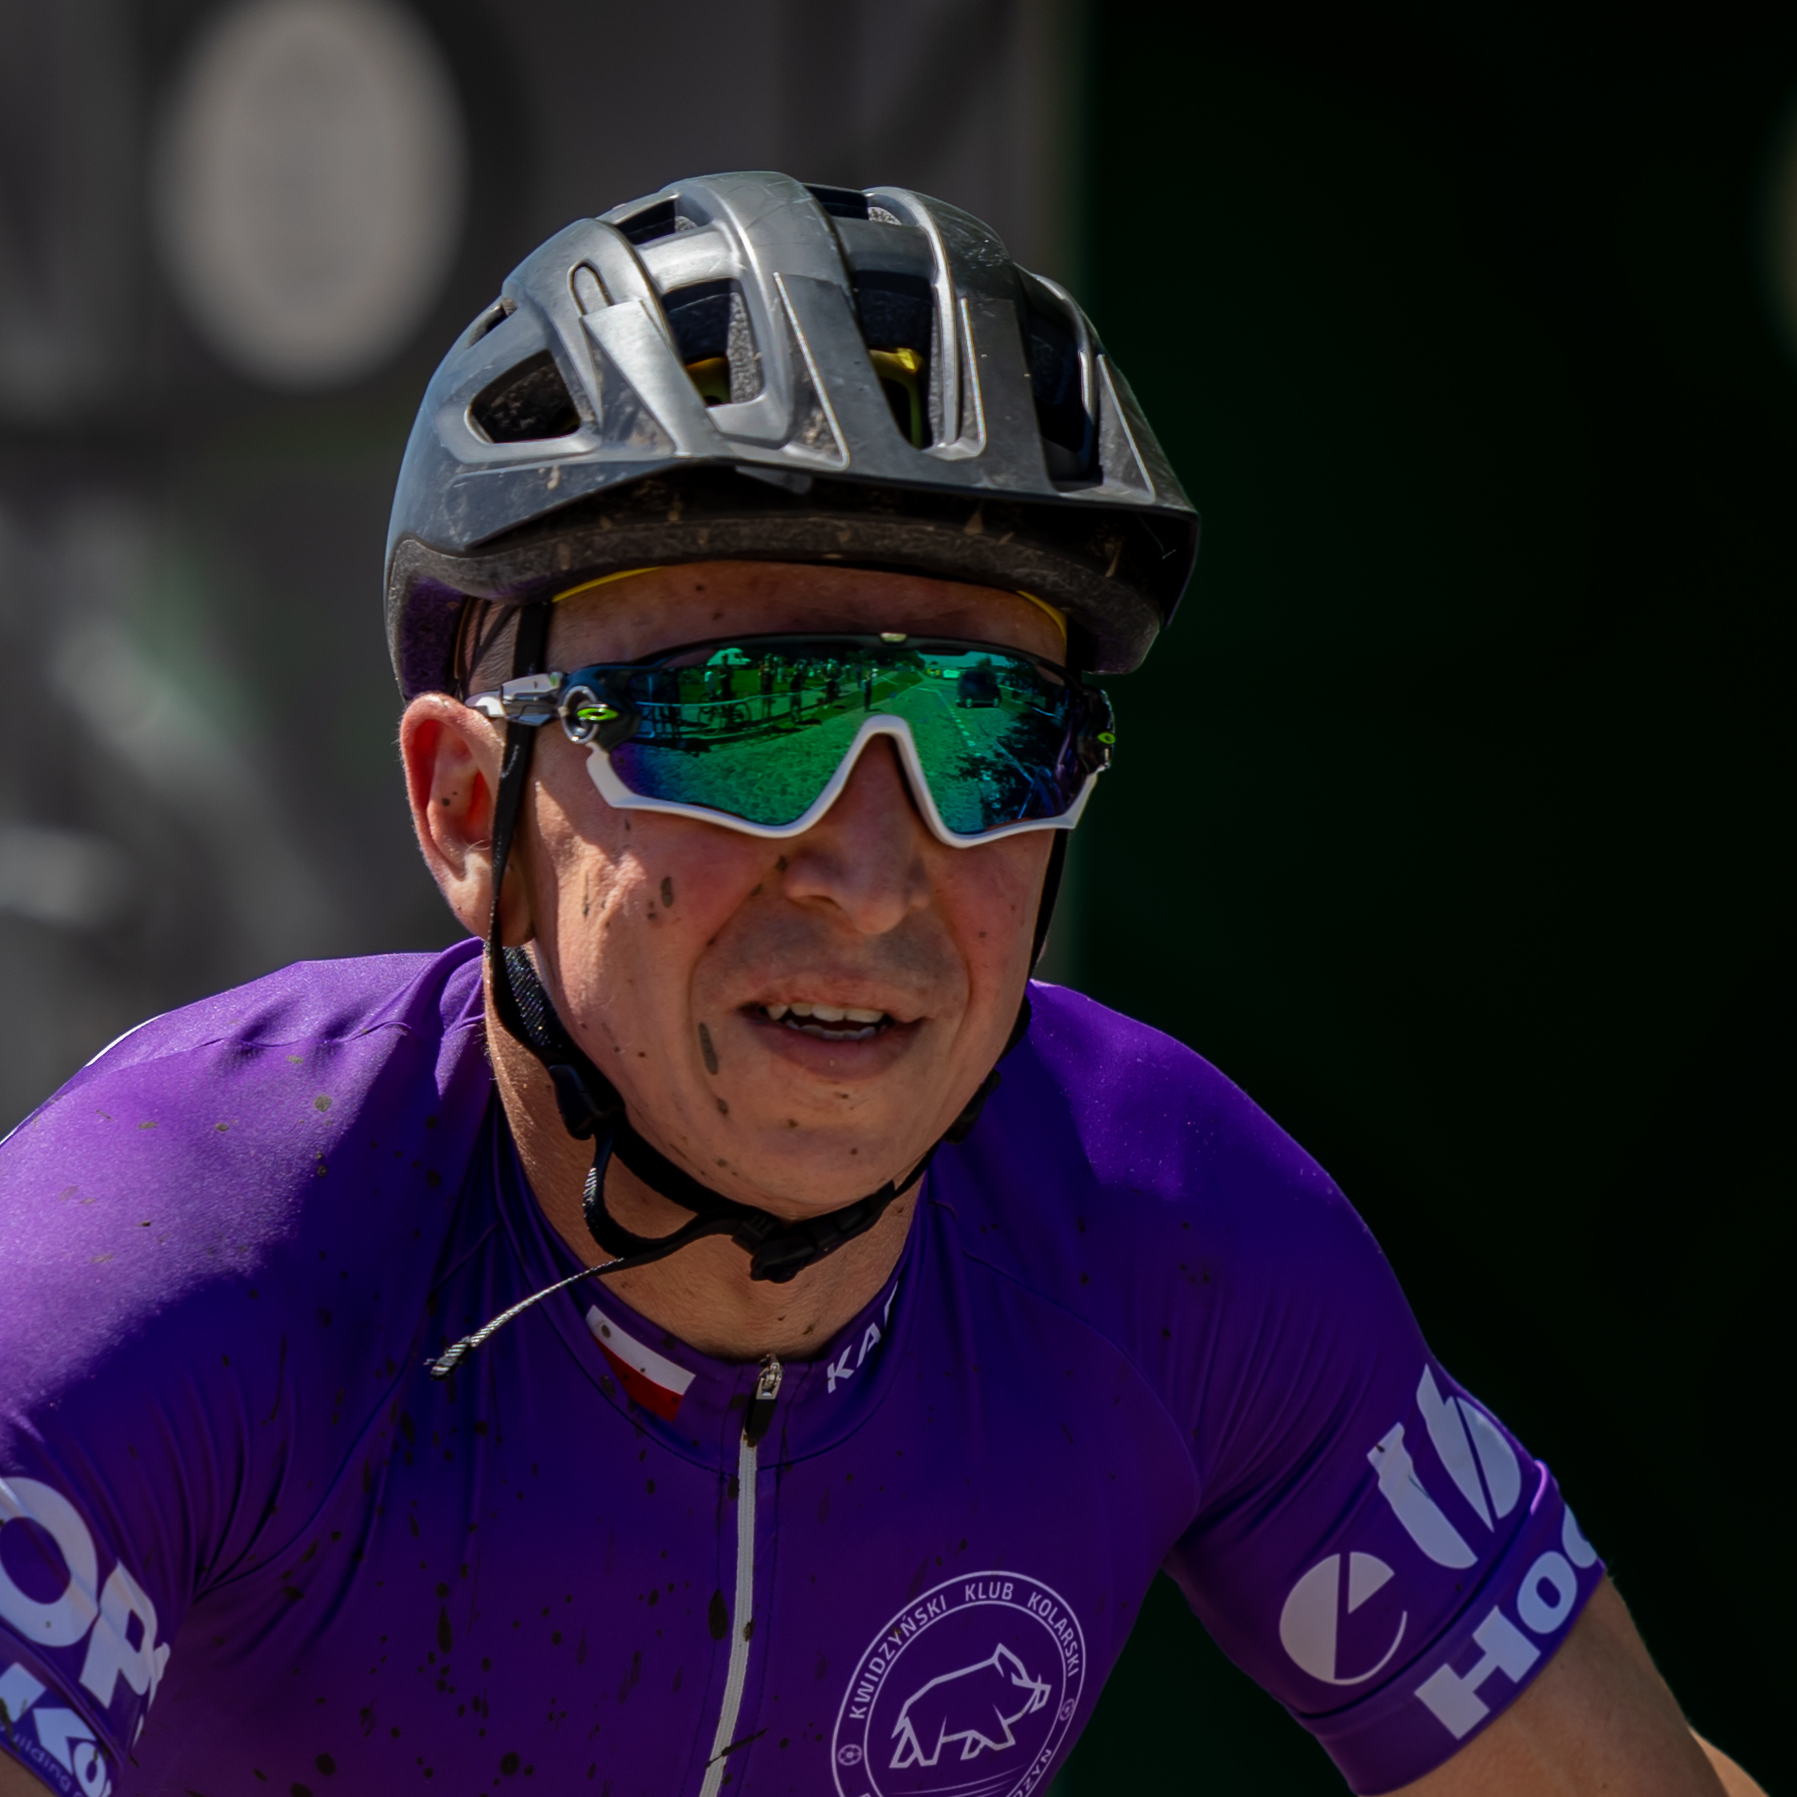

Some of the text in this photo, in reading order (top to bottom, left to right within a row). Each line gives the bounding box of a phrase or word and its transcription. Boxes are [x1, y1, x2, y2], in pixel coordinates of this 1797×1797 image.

[1279, 1363, 1521, 1686] elb
[848, 1581, 1080, 1720] KWIDZYŃSKI KLUB KOLARSKI
